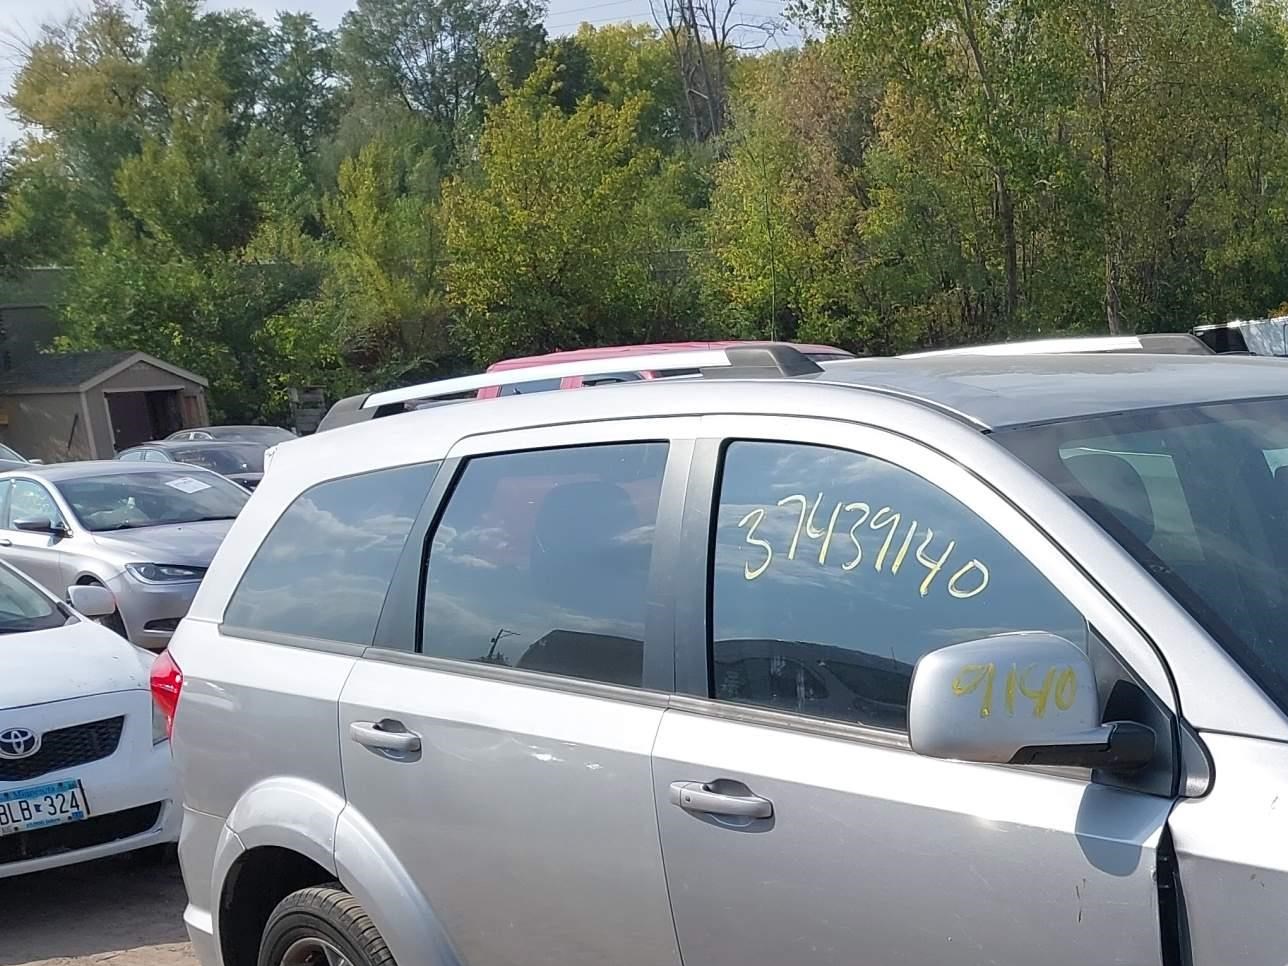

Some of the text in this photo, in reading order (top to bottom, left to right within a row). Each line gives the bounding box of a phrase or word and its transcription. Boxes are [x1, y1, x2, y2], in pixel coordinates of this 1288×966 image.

[737, 491, 990, 599] 37439140
[952, 662, 1077, 719] 9140
[43, 790, 80, 816] 324
